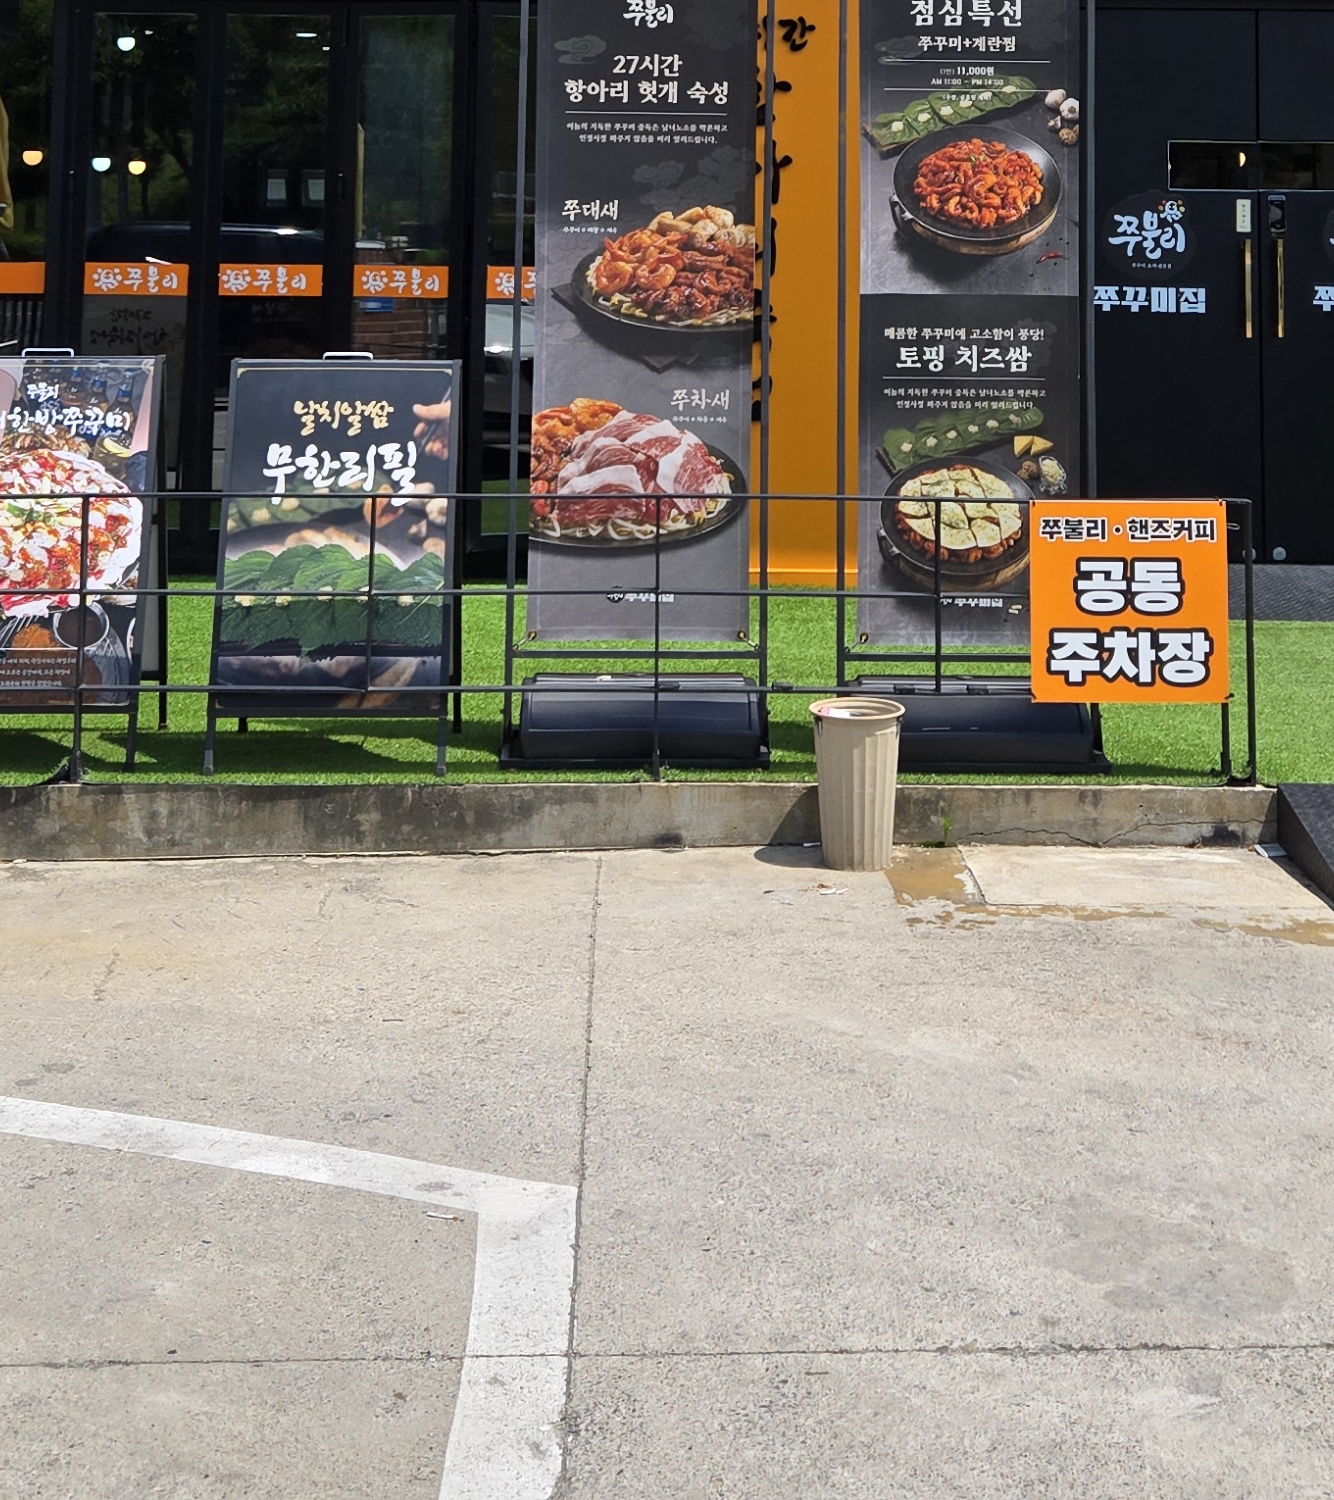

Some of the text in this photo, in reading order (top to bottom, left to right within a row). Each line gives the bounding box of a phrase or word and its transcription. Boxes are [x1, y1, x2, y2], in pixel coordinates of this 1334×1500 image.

[917, 35, 1017, 53] 쭈꾸미+계란찜
[612, 54, 683, 78] 27시간
[564, 79, 729, 105] 항아리 헛개 숙성
[562, 200, 619, 221] 쭈대새
[1108, 211, 1185, 260] 쭈불리
[122, 265, 179, 292] 쭈불리
[251, 266, 307, 293] 쭈불리
[389, 266, 440, 296] 쭈불리
[1093, 285, 1206, 314] 쭈꾸미집
[969, 328, 1014, 341] 고소함이
[896, 345, 1033, 373] 토핑 치즈쌈
[670, 389, 730, 411] 쭈차새
[294, 400, 395, 436] 날치알쌈
[263, 441, 418, 507] 무한리필
[1041, 518, 1107, 541] 쭈불리
[1128, 518, 1216, 542] 핸즈커피
[1076, 560, 1183, 613] 공동
[1049, 630, 1211, 684] 주차장
